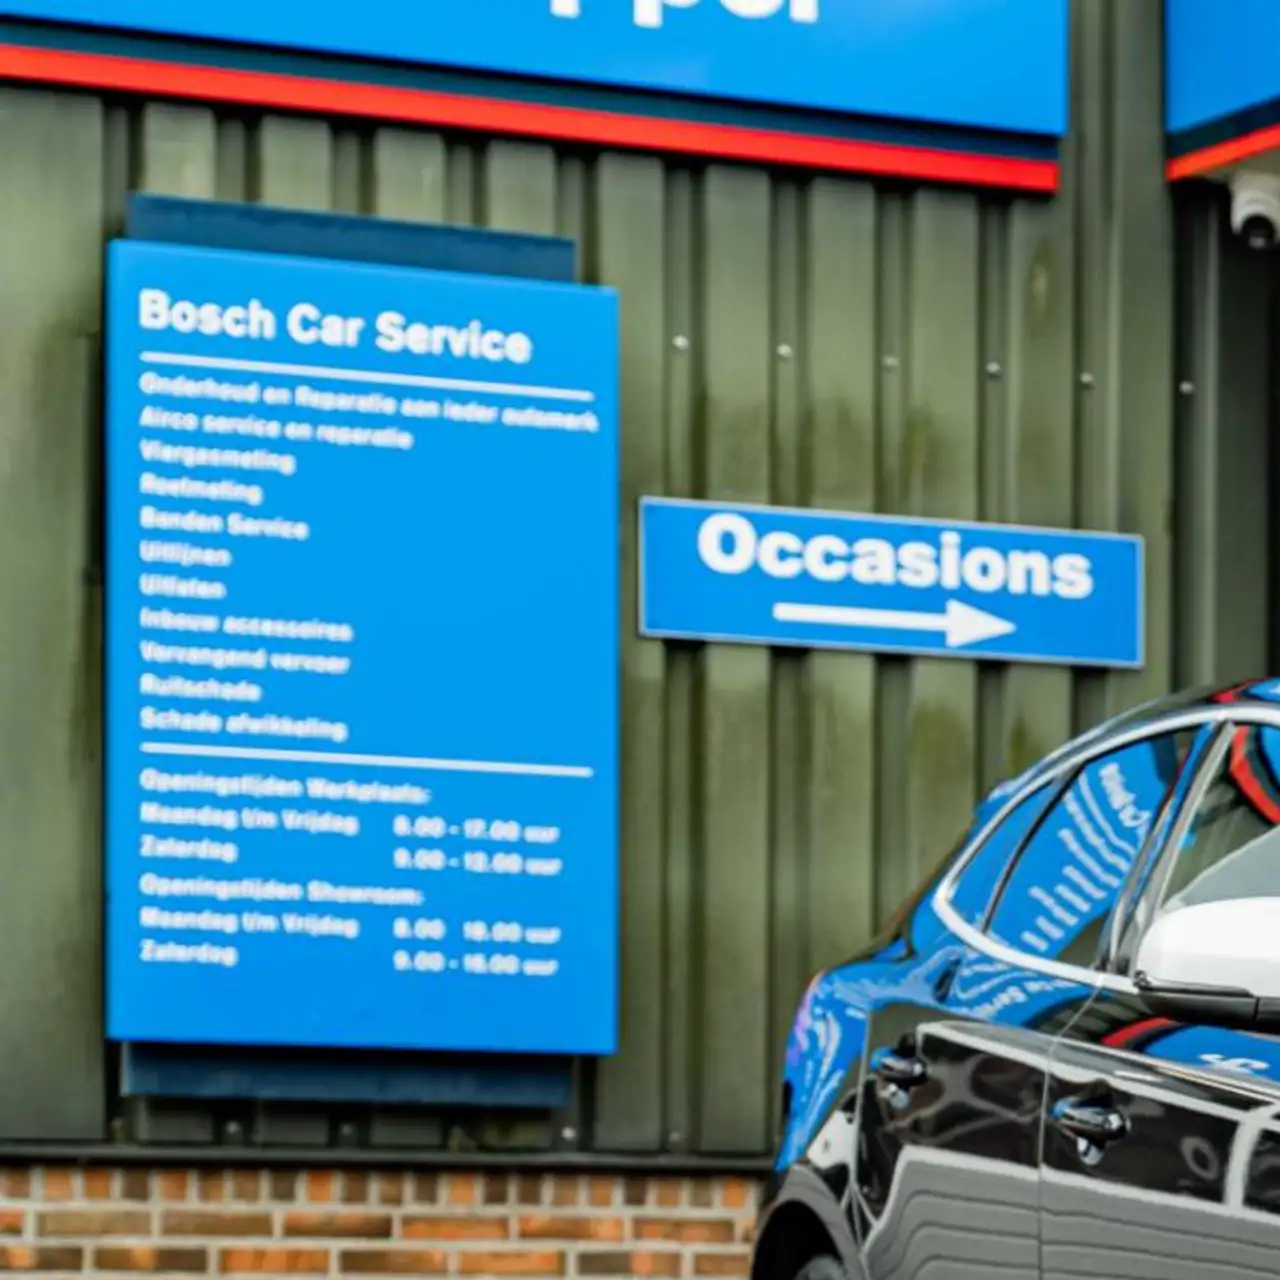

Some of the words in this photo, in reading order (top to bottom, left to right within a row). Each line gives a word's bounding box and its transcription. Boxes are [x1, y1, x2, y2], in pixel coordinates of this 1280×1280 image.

[140, 289, 275, 339] Bosch
[287, 304, 364, 346] Car
[376, 312, 531, 363] Service
[140, 406, 199, 430] Airco
[202, 415, 281, 437] service
[283, 423, 312, 438] en
[140, 506, 223, 531] Banden
[227, 513, 308, 539] Service
[698, 513, 1092, 598] Occasions
